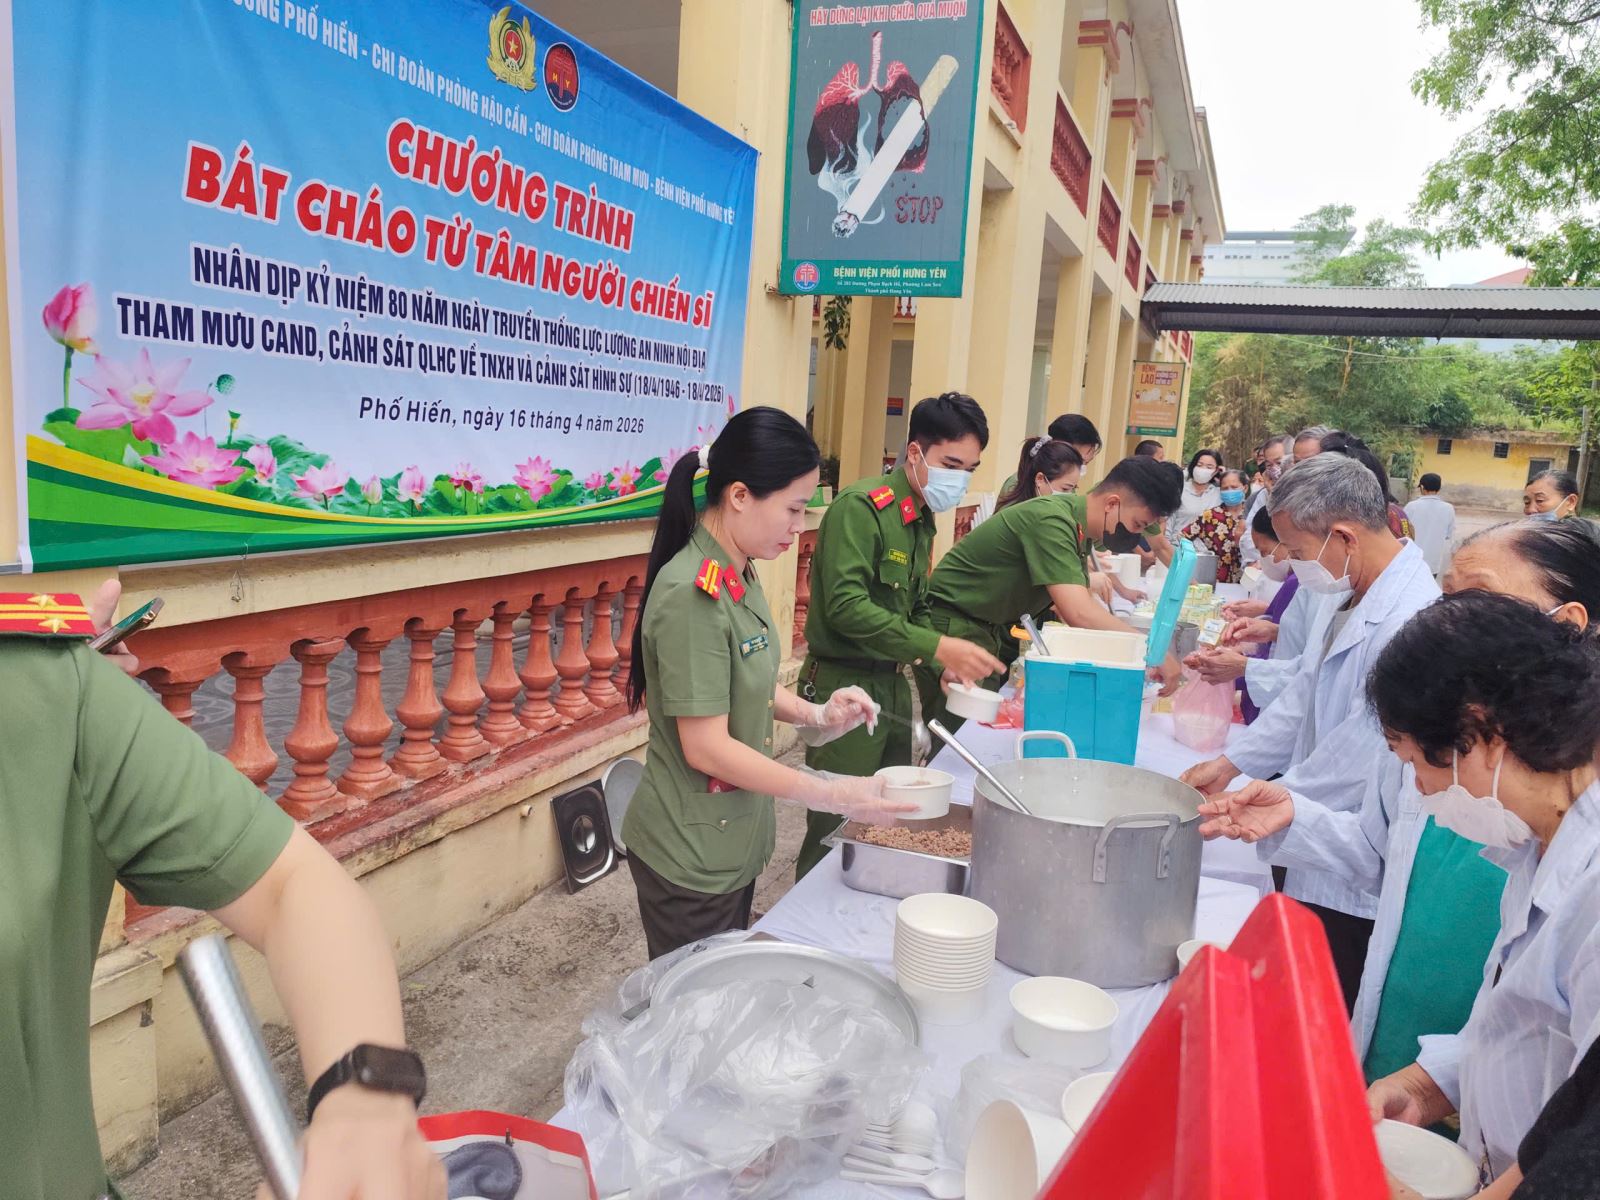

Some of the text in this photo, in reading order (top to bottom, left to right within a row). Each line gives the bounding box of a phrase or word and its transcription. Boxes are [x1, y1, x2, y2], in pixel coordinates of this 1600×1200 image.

[811, 6, 829, 26] HÃY
[855, 6, 871, 27] LẠI
[872, 5, 890, 23] KHI
[232, 0, 280, 24] NG
[284, 0, 319, 41] PHỐ
[322, 18, 358, 60] HIẾN
[371, 42, 395, 77] CHI
[398, 55, 435, 95] ĐOÀN
[437, 74, 479, 115] PHÒNG
[481, 94, 503, 127] HẬU
[534, 121, 552, 148] CHI
[553, 129, 578, 160] ĐOÀN
[579, 142, 608, 173] PHÒNG
[609, 156, 632, 183] THAM
[632, 167, 650, 191] MƯU
[655, 176, 674, 202] BỆNH
[675, 186, 691, 210] VIỆN
[184, 143, 714, 328] BÁT CHÁO TỪ TÂM NGƯỜI CHIẾN SĨ
[386, 119, 635, 251] CHƯƠNG TRÌNH
[896, 195, 944, 224] STOP
[193, 246, 706, 373] NHÂN DỊP KỶ NIỆM 80 NĂM NGÀY TRUYỀN THỐNG LỰC LƯỢNG AN NINH NỘI ĐỊA
[833, 265, 857, 280] BỆNH
[858, 265, 878, 280] VIỆN
[902, 267, 927, 279] HƯNG
[116, 296, 195, 343] THAM
[201, 310, 255, 350] MƯU
[261, 319, 324, 362] CAND,
[328, 321, 378, 365] CẢNH
[382, 334, 414, 369] SÁT
[418, 342, 456, 375] QLHC
[459, 342, 477, 377] VỀ
[479, 352, 515, 381] TNXH
[517, 353, 533, 383] VÀ
[535, 353, 567, 387] CẢNH
[569, 361, 590, 389] SÁT
[592, 364, 617, 392] HÌNH
[618, 371, 633, 399] SỰ
[634, 374, 680, 399] (18/4/1946
[358, 395, 646, 435] Phố Hiến, ngày 16 tháng 4 năm 2026
